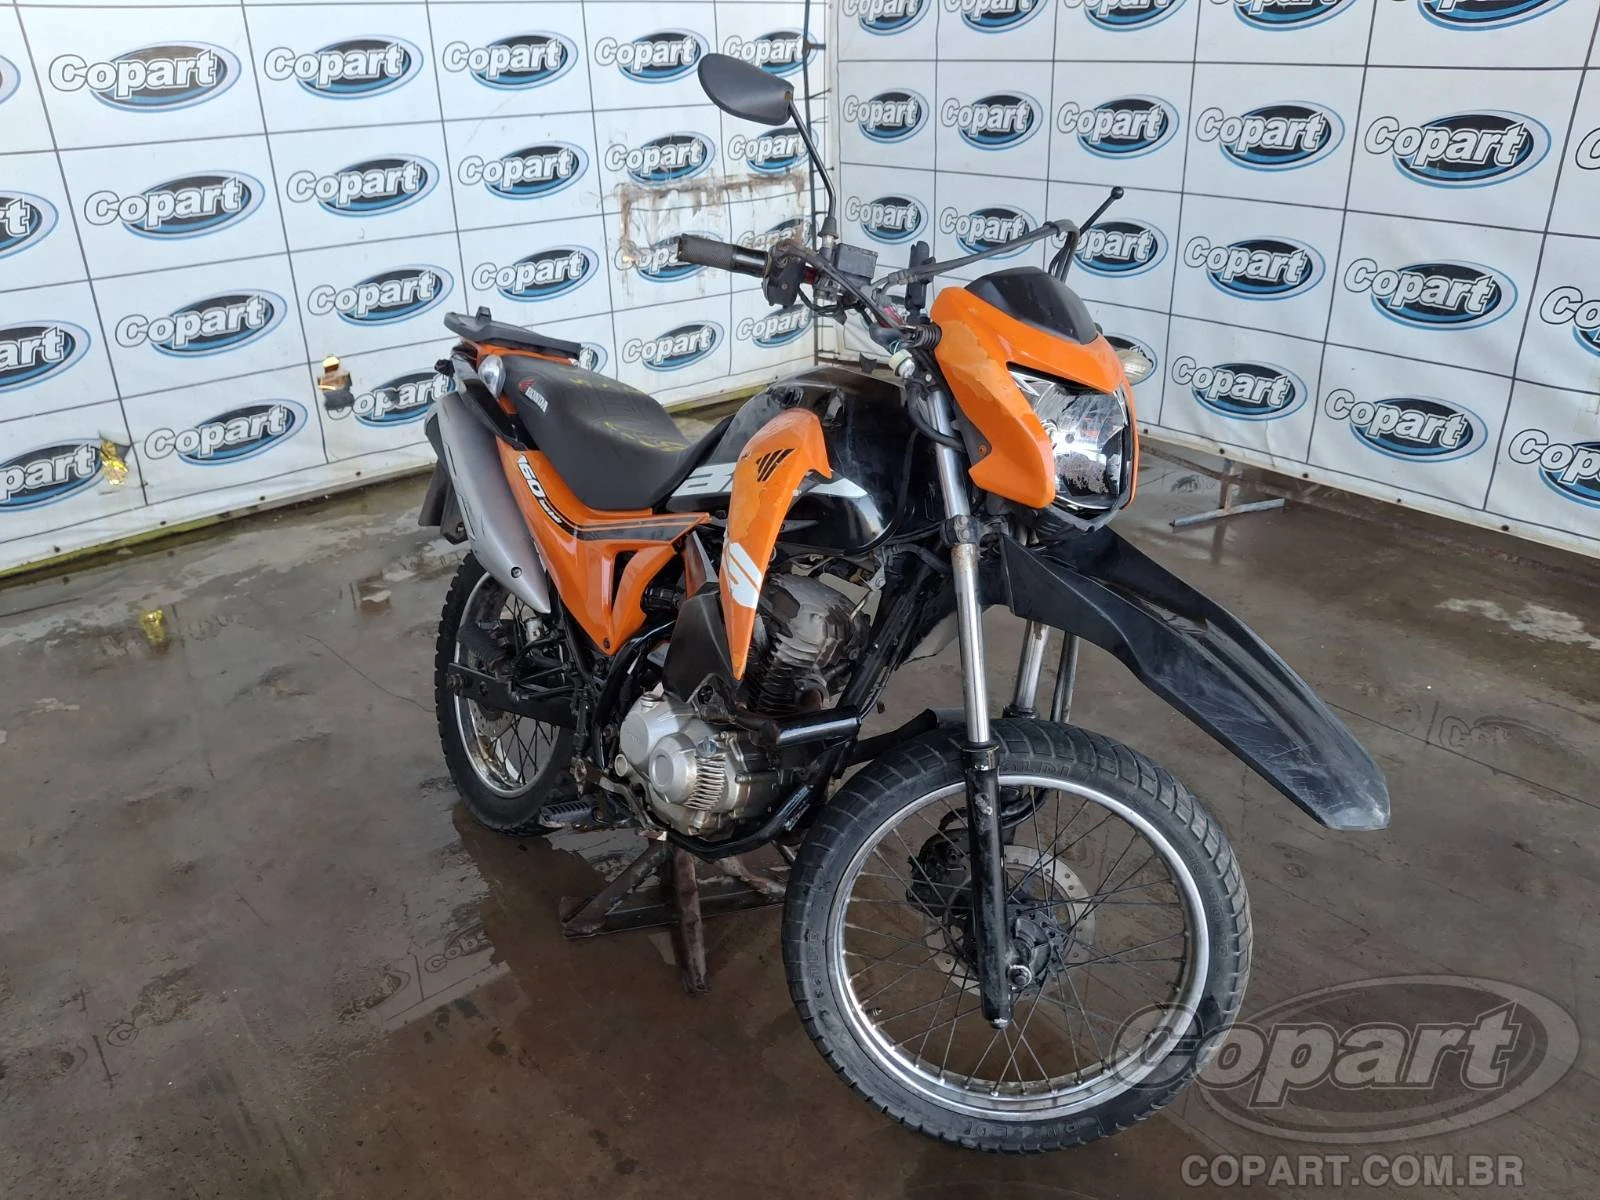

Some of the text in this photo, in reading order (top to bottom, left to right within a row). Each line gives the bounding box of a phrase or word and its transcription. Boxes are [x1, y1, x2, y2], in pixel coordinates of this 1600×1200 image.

[49, 49, 218, 99] Copart
[264, 43, 405, 87] Copart
[443, 38, 563, 77] Copart
[595, 35, 701, 73] Copart
[843, 95, 919, 131] Copart
[941, 97, 1032, 137] Copart
[1057, 102, 1164, 144] Copart
[1196, 107, 1326, 154] Copart
[605, 138, 704, 178] Copart
[1364, 116, 1527, 168] Copart
[287, 161, 421, 208] Copart
[458, 146, 573, 191] Copart
[84, 177, 244, 230] Copart
[845, 196, 920, 232] Copart
[939, 207, 1025, 246] Copart
[472, 250, 587, 294] Copart
[1184, 236, 1308, 285] Copart
[308, 270, 437, 317] Copart
[1344, 258, 1497, 315] Copart
[115, 294, 265, 348] Copart
[736, 308, 810, 341] Copart
[622, 325, 714, 366] Copart
[1172, 356, 1290, 408] Copart
[145, 403, 289, 460] Copart
[1325, 389, 1467, 449] Copart
[0, 443, 96, 501] part
[1508, 428, 1600, 485] Cop
